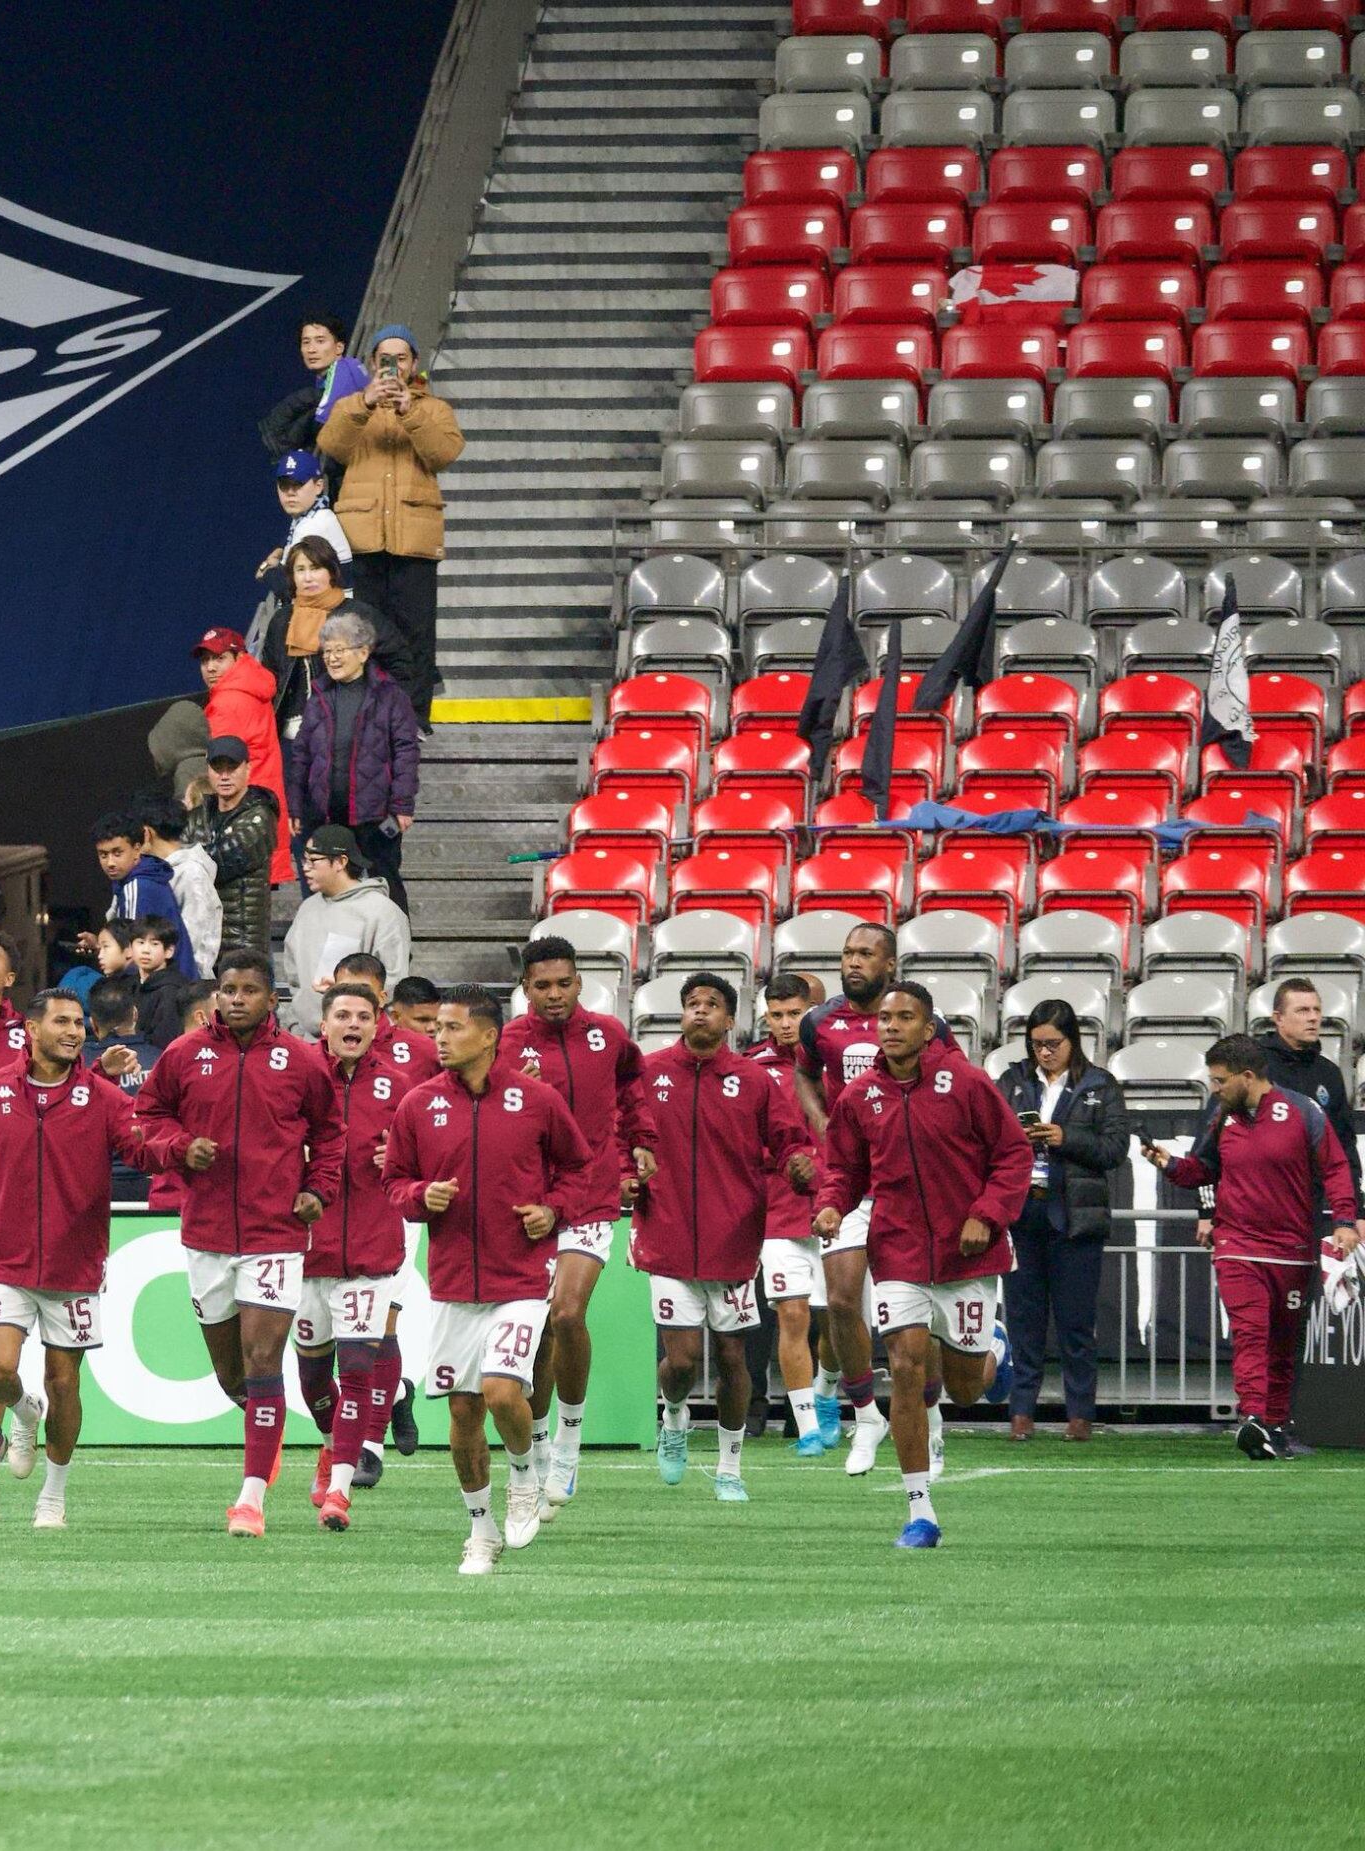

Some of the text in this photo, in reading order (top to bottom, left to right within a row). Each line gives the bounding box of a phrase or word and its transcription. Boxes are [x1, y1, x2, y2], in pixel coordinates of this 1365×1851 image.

[9, 1028, 26, 1049] S
[587, 1028, 606, 1051] S
[269, 1047, 289, 1070] S
[392, 1042, 411, 1064] S
[201, 1064, 212, 1075] 21
[373, 1077, 392, 1100] S
[722, 1075, 741, 1097] S
[934, 1071, 953, 1094] S
[37, 1093, 48, 1105] 15
[71, 1086, 90, 1106] S
[503, 1088, 523, 1112] S
[657, 1091, 668, 1102] 42
[1, 1102, 11, 1114] 15
[1272, 1102, 1290, 1122] S
[434, 1114, 448, 1127] 28
[257, 1259, 285, 1290] 21
[772, 1272, 786, 1292] S
[192, 1297, 204, 1318] S
[342, 1290, 375, 1321] 37
[658, 1298, 674, 1319] S
[724, 1284, 755, 1312] 42
[1286, 1290, 1302, 1310] S
[62, 1297, 93, 1331] 15
[877, 1303, 889, 1325] S
[955, 1301, 984, 1334] 19
[297, 1319, 314, 1340] S
[494, 1322, 533, 1358] 28
[435, 1365, 455, 1390] S
[372, 1389, 386, 1405] S
[255, 1407, 276, 1427] S
[341, 1401, 358, 1420] S
